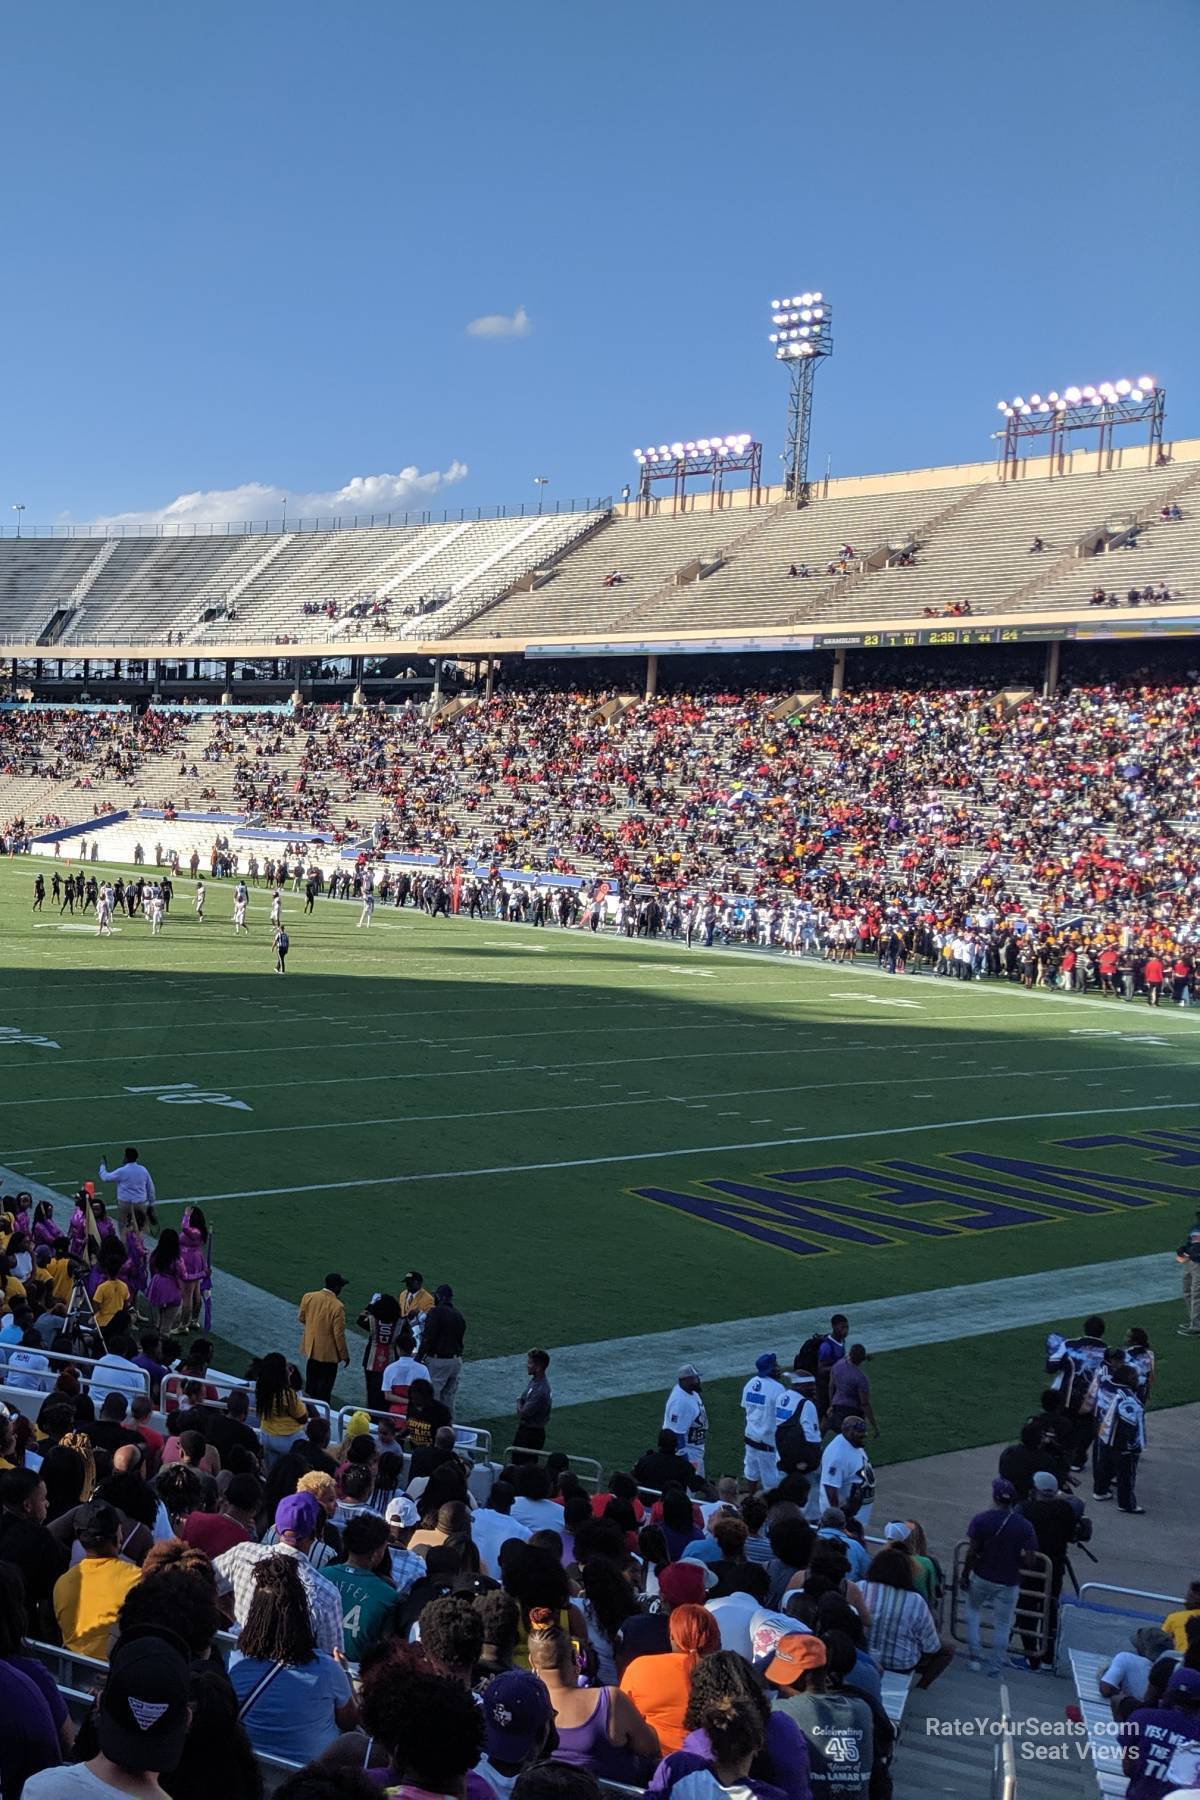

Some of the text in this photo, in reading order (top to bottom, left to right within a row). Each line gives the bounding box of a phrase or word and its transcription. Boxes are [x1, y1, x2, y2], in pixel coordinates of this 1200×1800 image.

[863, 635, 879, 646] 23
[928, 631, 956, 643] 2:39
[1001, 629, 1018, 640] 24
[123, 1082, 234, 1105] 10
[342, 1604, 362, 1638] 4
[812, 1725, 864, 1741] Celebrating
[1144, 1724, 1169, 1741] YES!
[825, 1737, 860, 1762] 45
[827, 1772, 859, 1781] LAMAR
